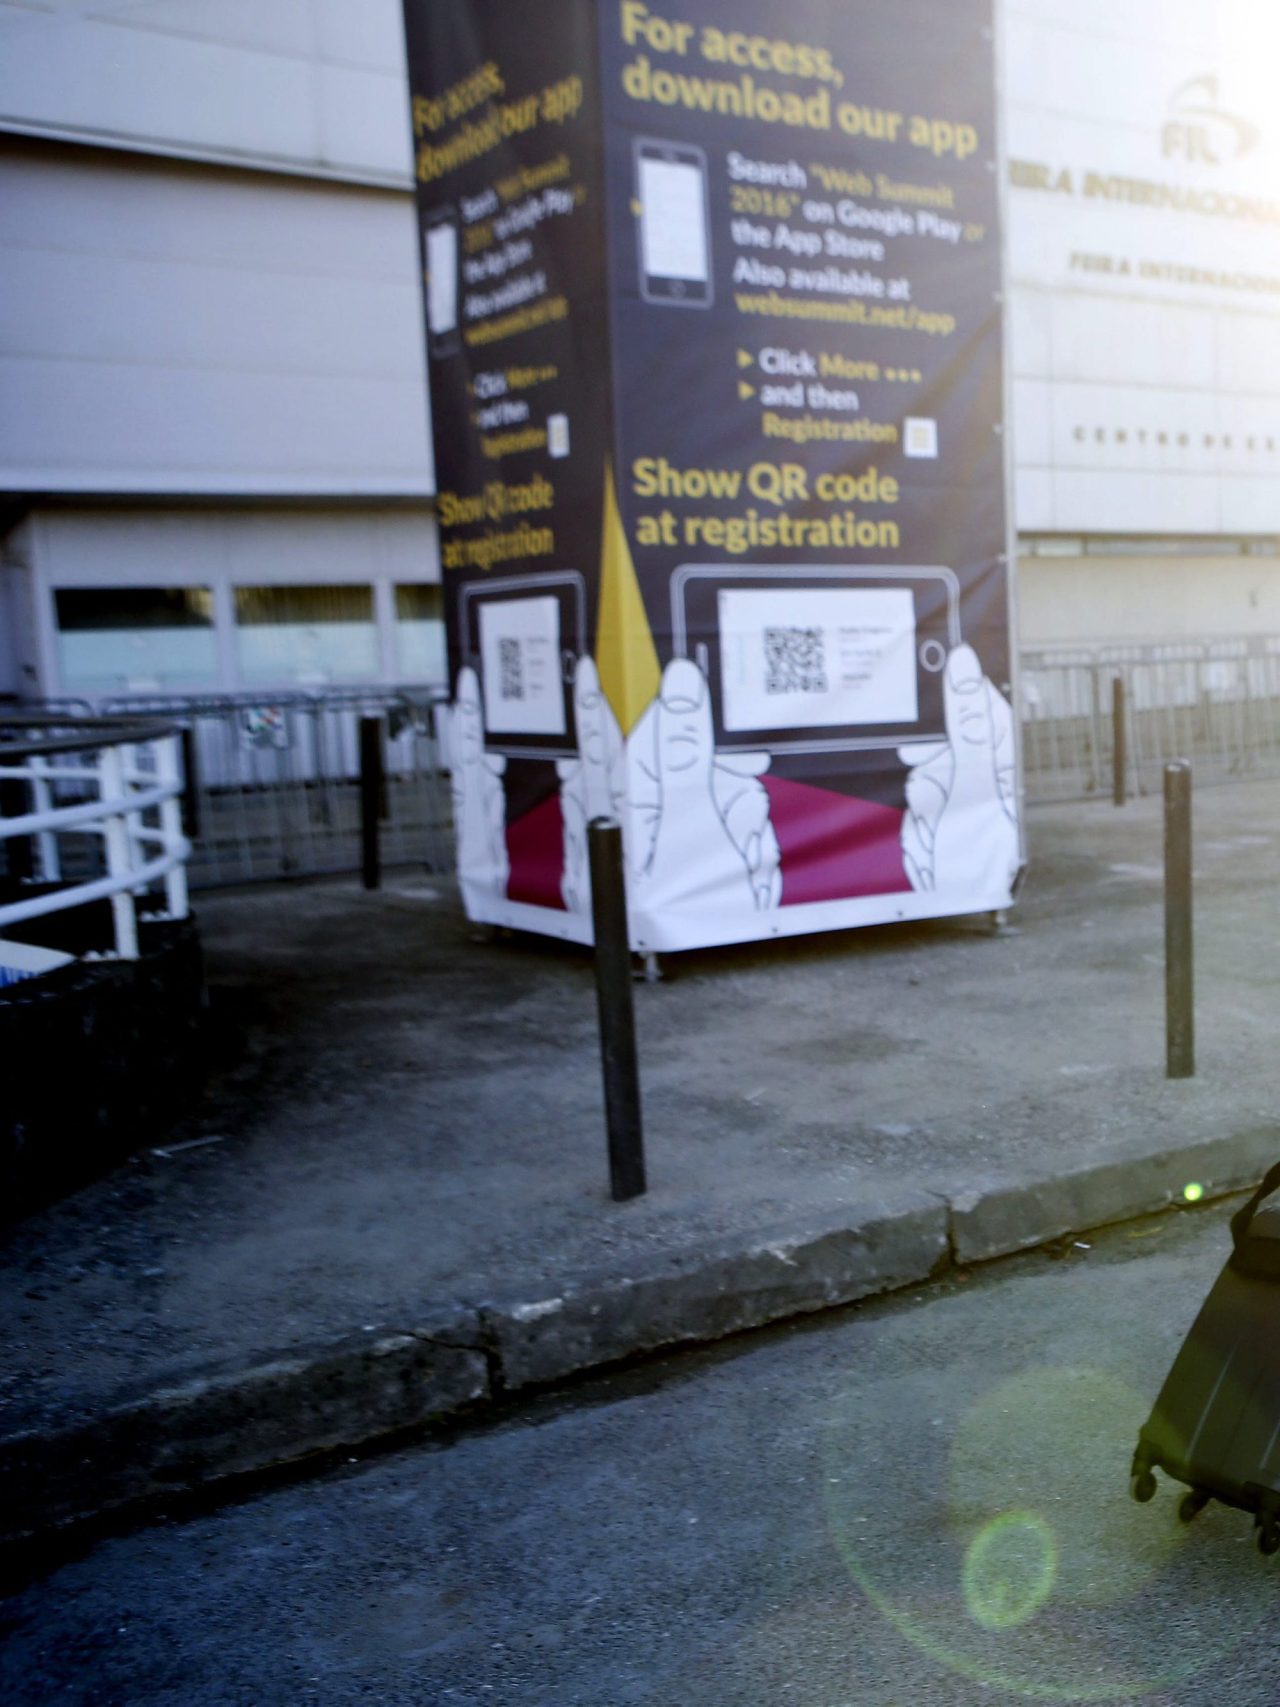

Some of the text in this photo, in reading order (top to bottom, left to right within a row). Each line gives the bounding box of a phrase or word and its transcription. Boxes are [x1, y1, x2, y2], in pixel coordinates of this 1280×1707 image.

[621, 2, 843, 87] For access,
[503, 97, 537, 134] our
[543, 75, 581, 123] app
[623, 57, 977, 159] download our app
[728, 152, 806, 188] Search
[732, 220, 884, 260] the App Store
[803, 201, 834, 222] on
[837, 200, 913, 236] Google
[916, 210, 961, 242] Play
[734, 257, 909, 300] Also available at
[760, 348, 878, 380] Click More
[761, 383, 858, 410] and then
[763, 412, 897, 443] Registration
[632, 458, 898, 504] Show QR code
[637, 510, 898, 553] at registration
